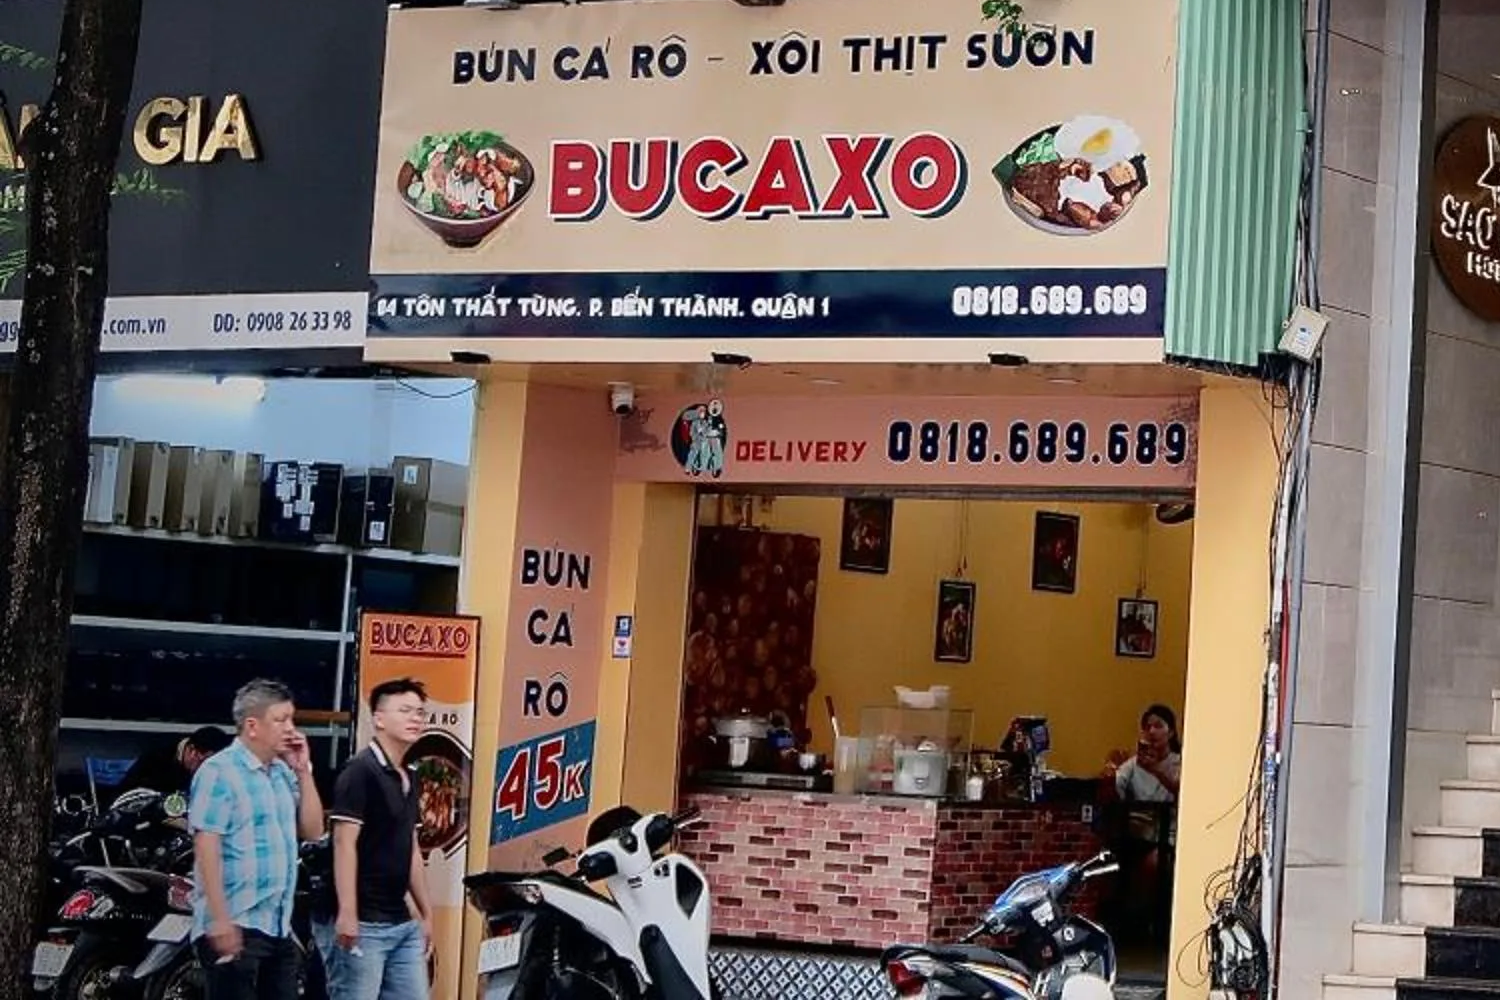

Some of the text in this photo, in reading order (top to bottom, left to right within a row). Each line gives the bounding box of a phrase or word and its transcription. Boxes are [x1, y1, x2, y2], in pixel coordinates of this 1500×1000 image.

[453, 41, 537, 84] BÚN
[553, 36, 611, 81] CÁ
[630, 34, 688, 79] RÔ
[749, 31, 821, 75] XÔI
[843, 34, 947, 76] THỊT
[133, 94, 261, 166] GIA
[548, 132, 968, 223] BUCAXO
[1441, 194, 1497, 250] SAO
[247, 312, 284, 332] 0908
[288, 312, 309, 332] 26
[312, 311, 330, 331] 33
[333, 310, 352, 331] 98
[403, 293, 446, 317] TÔN
[452, 286, 512, 317] THẤT
[589, 297, 603, 317] P.
[611, 286, 654, 317] BẾN
[751, 292, 815, 319] QUẬN
[820, 297, 830, 317] 1
[953, 284, 1148, 317] 0818.689.689
[735, 418, 1189, 466] DELIVERY 0818.689.689
[521, 541, 592, 590] BÚN
[370, 621, 471, 652] BUCAXO
[527, 604, 576, 647] CÁ
[522, 671, 570, 718] RÔ
[495, 735, 588, 821] 45K
